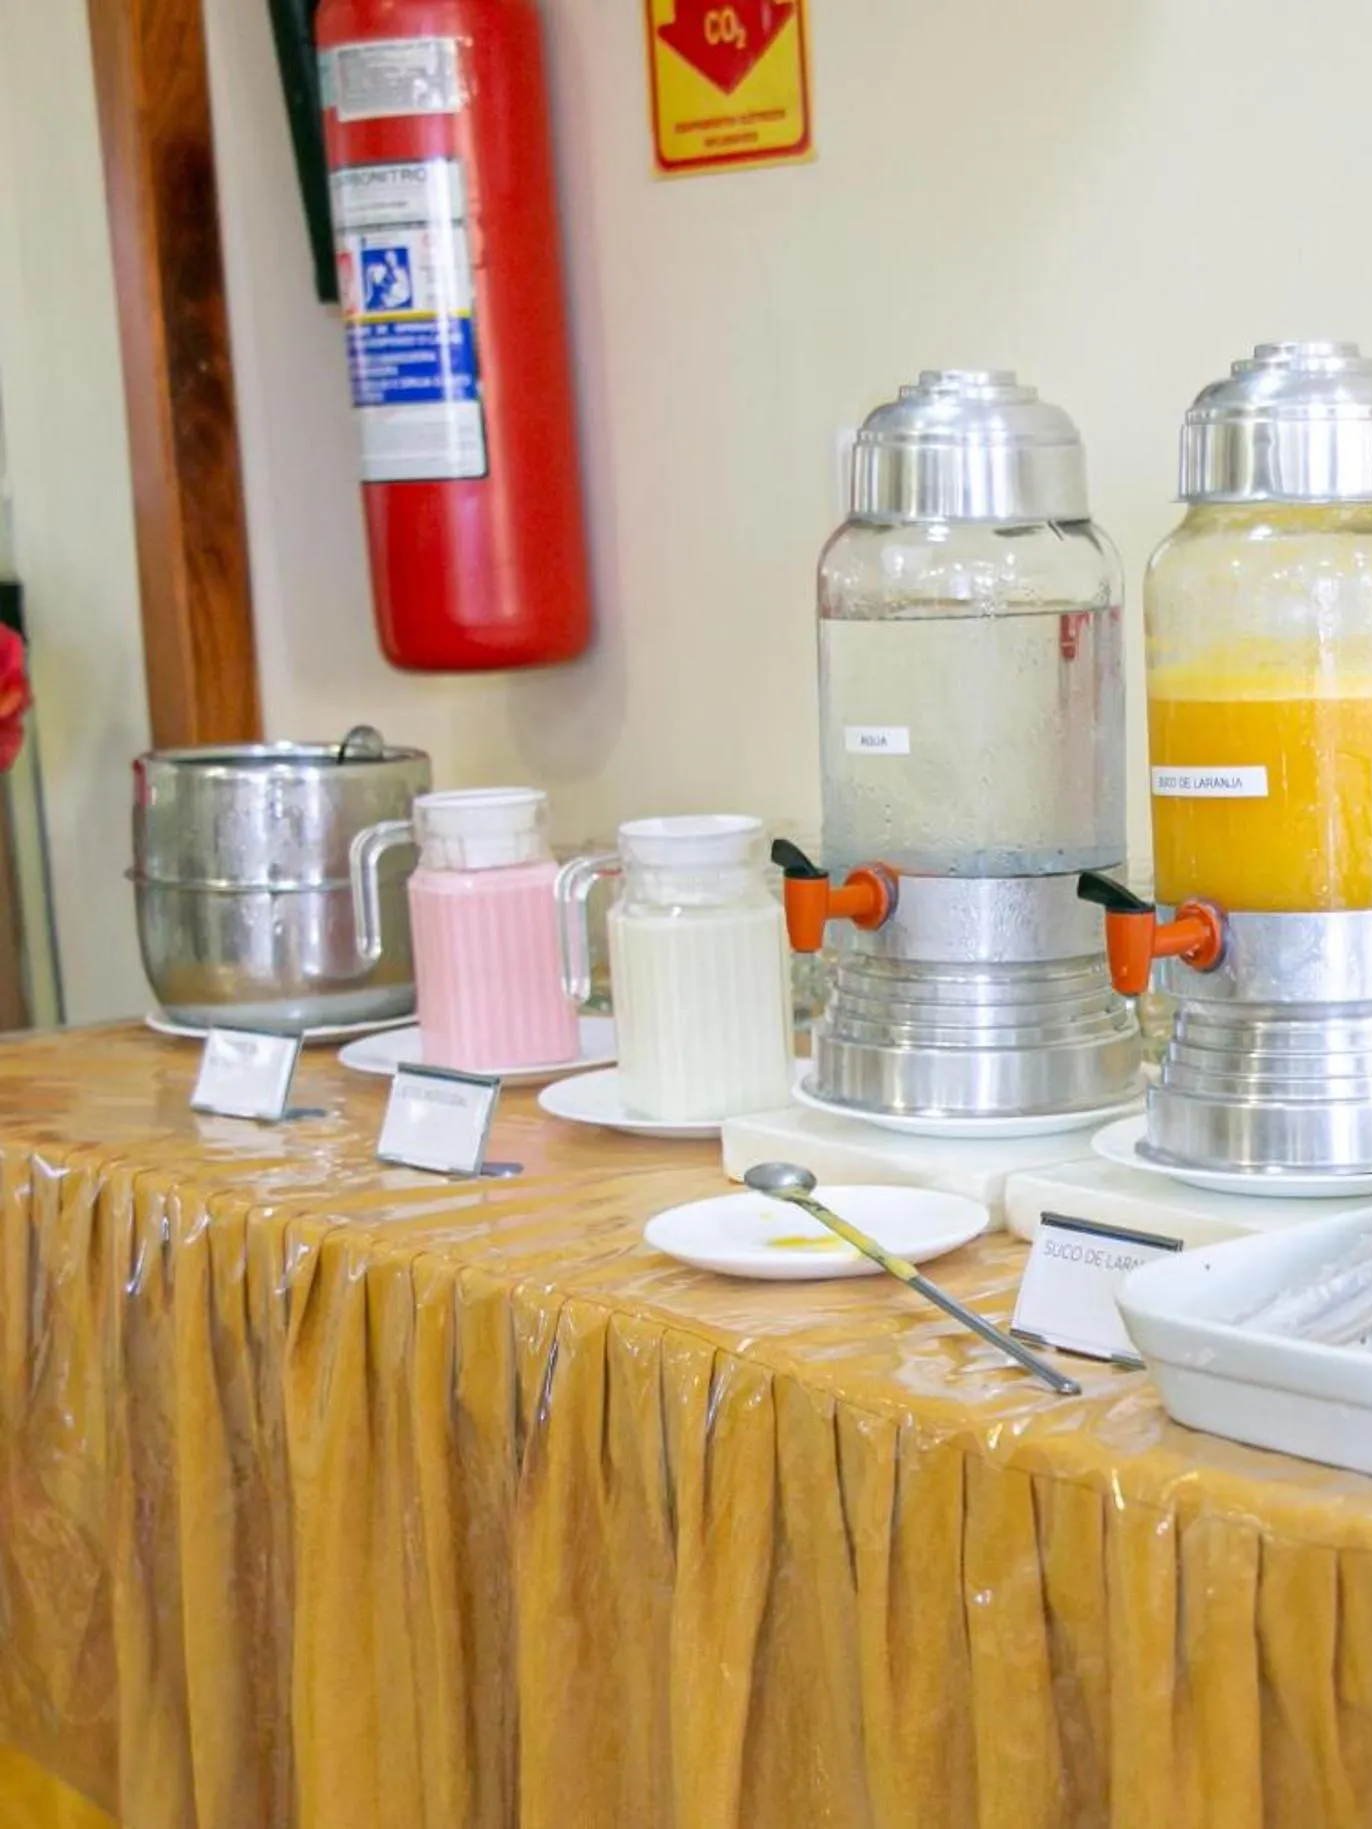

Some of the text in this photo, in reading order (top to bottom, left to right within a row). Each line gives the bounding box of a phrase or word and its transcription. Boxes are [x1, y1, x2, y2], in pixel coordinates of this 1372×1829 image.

[1179, 775, 1191, 790] DE
[1193, 775, 1243, 790] LARANJA
[1043, 1240, 1146, 1272] SUCO DE LARA
